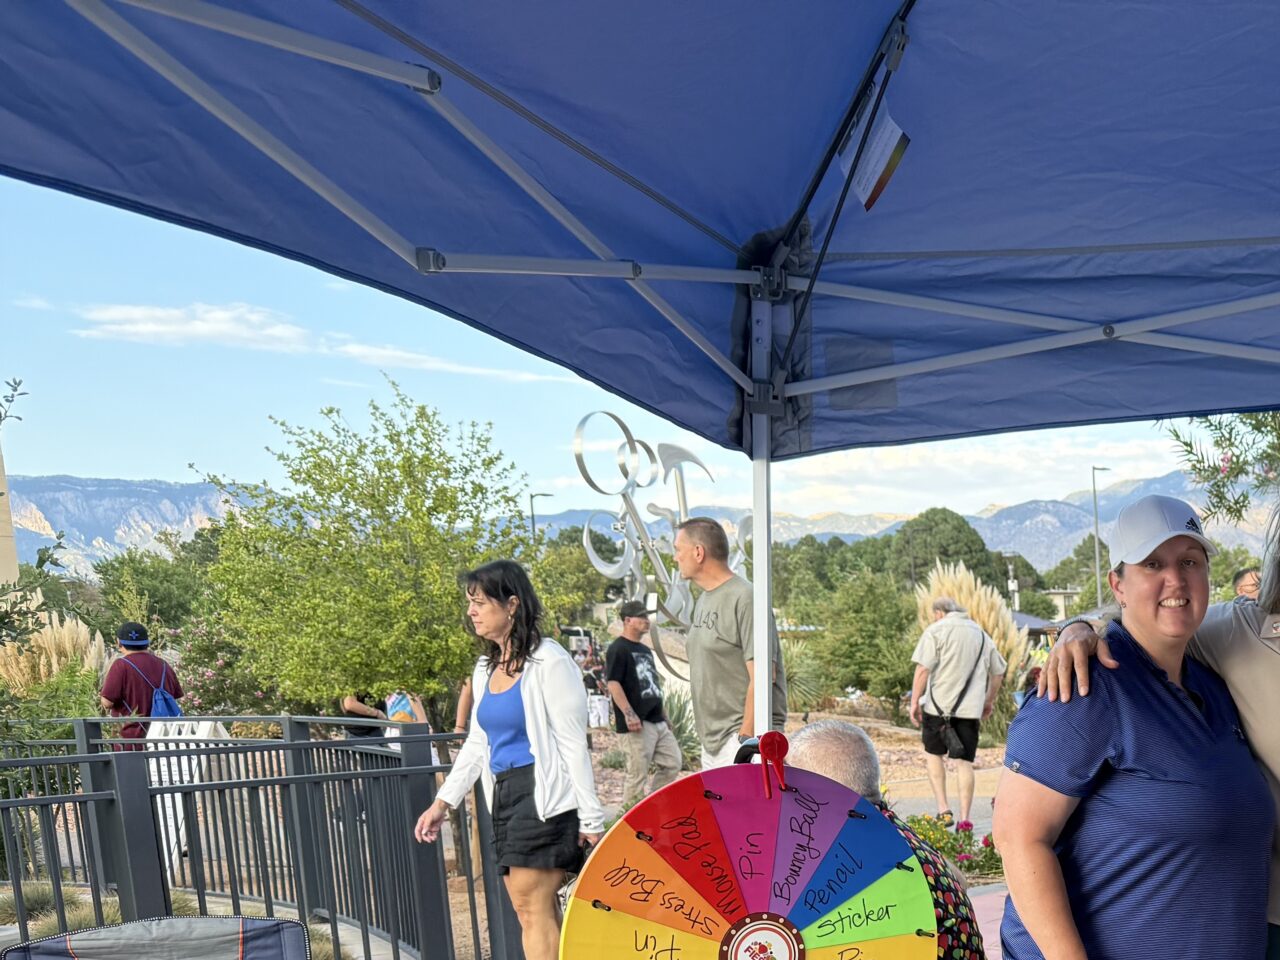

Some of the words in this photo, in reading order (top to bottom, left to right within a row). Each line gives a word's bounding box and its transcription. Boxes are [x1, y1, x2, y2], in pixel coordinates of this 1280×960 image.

[660, 808, 711, 861] Pad
[789, 789, 830, 842] Ball
[603, 858, 665, 903] Ball
[738, 831, 764, 881] Pin
[773, 839, 820, 906] Bouncy
[803, 842, 863, 914] Pencil
[659, 891, 720, 936] Stress
